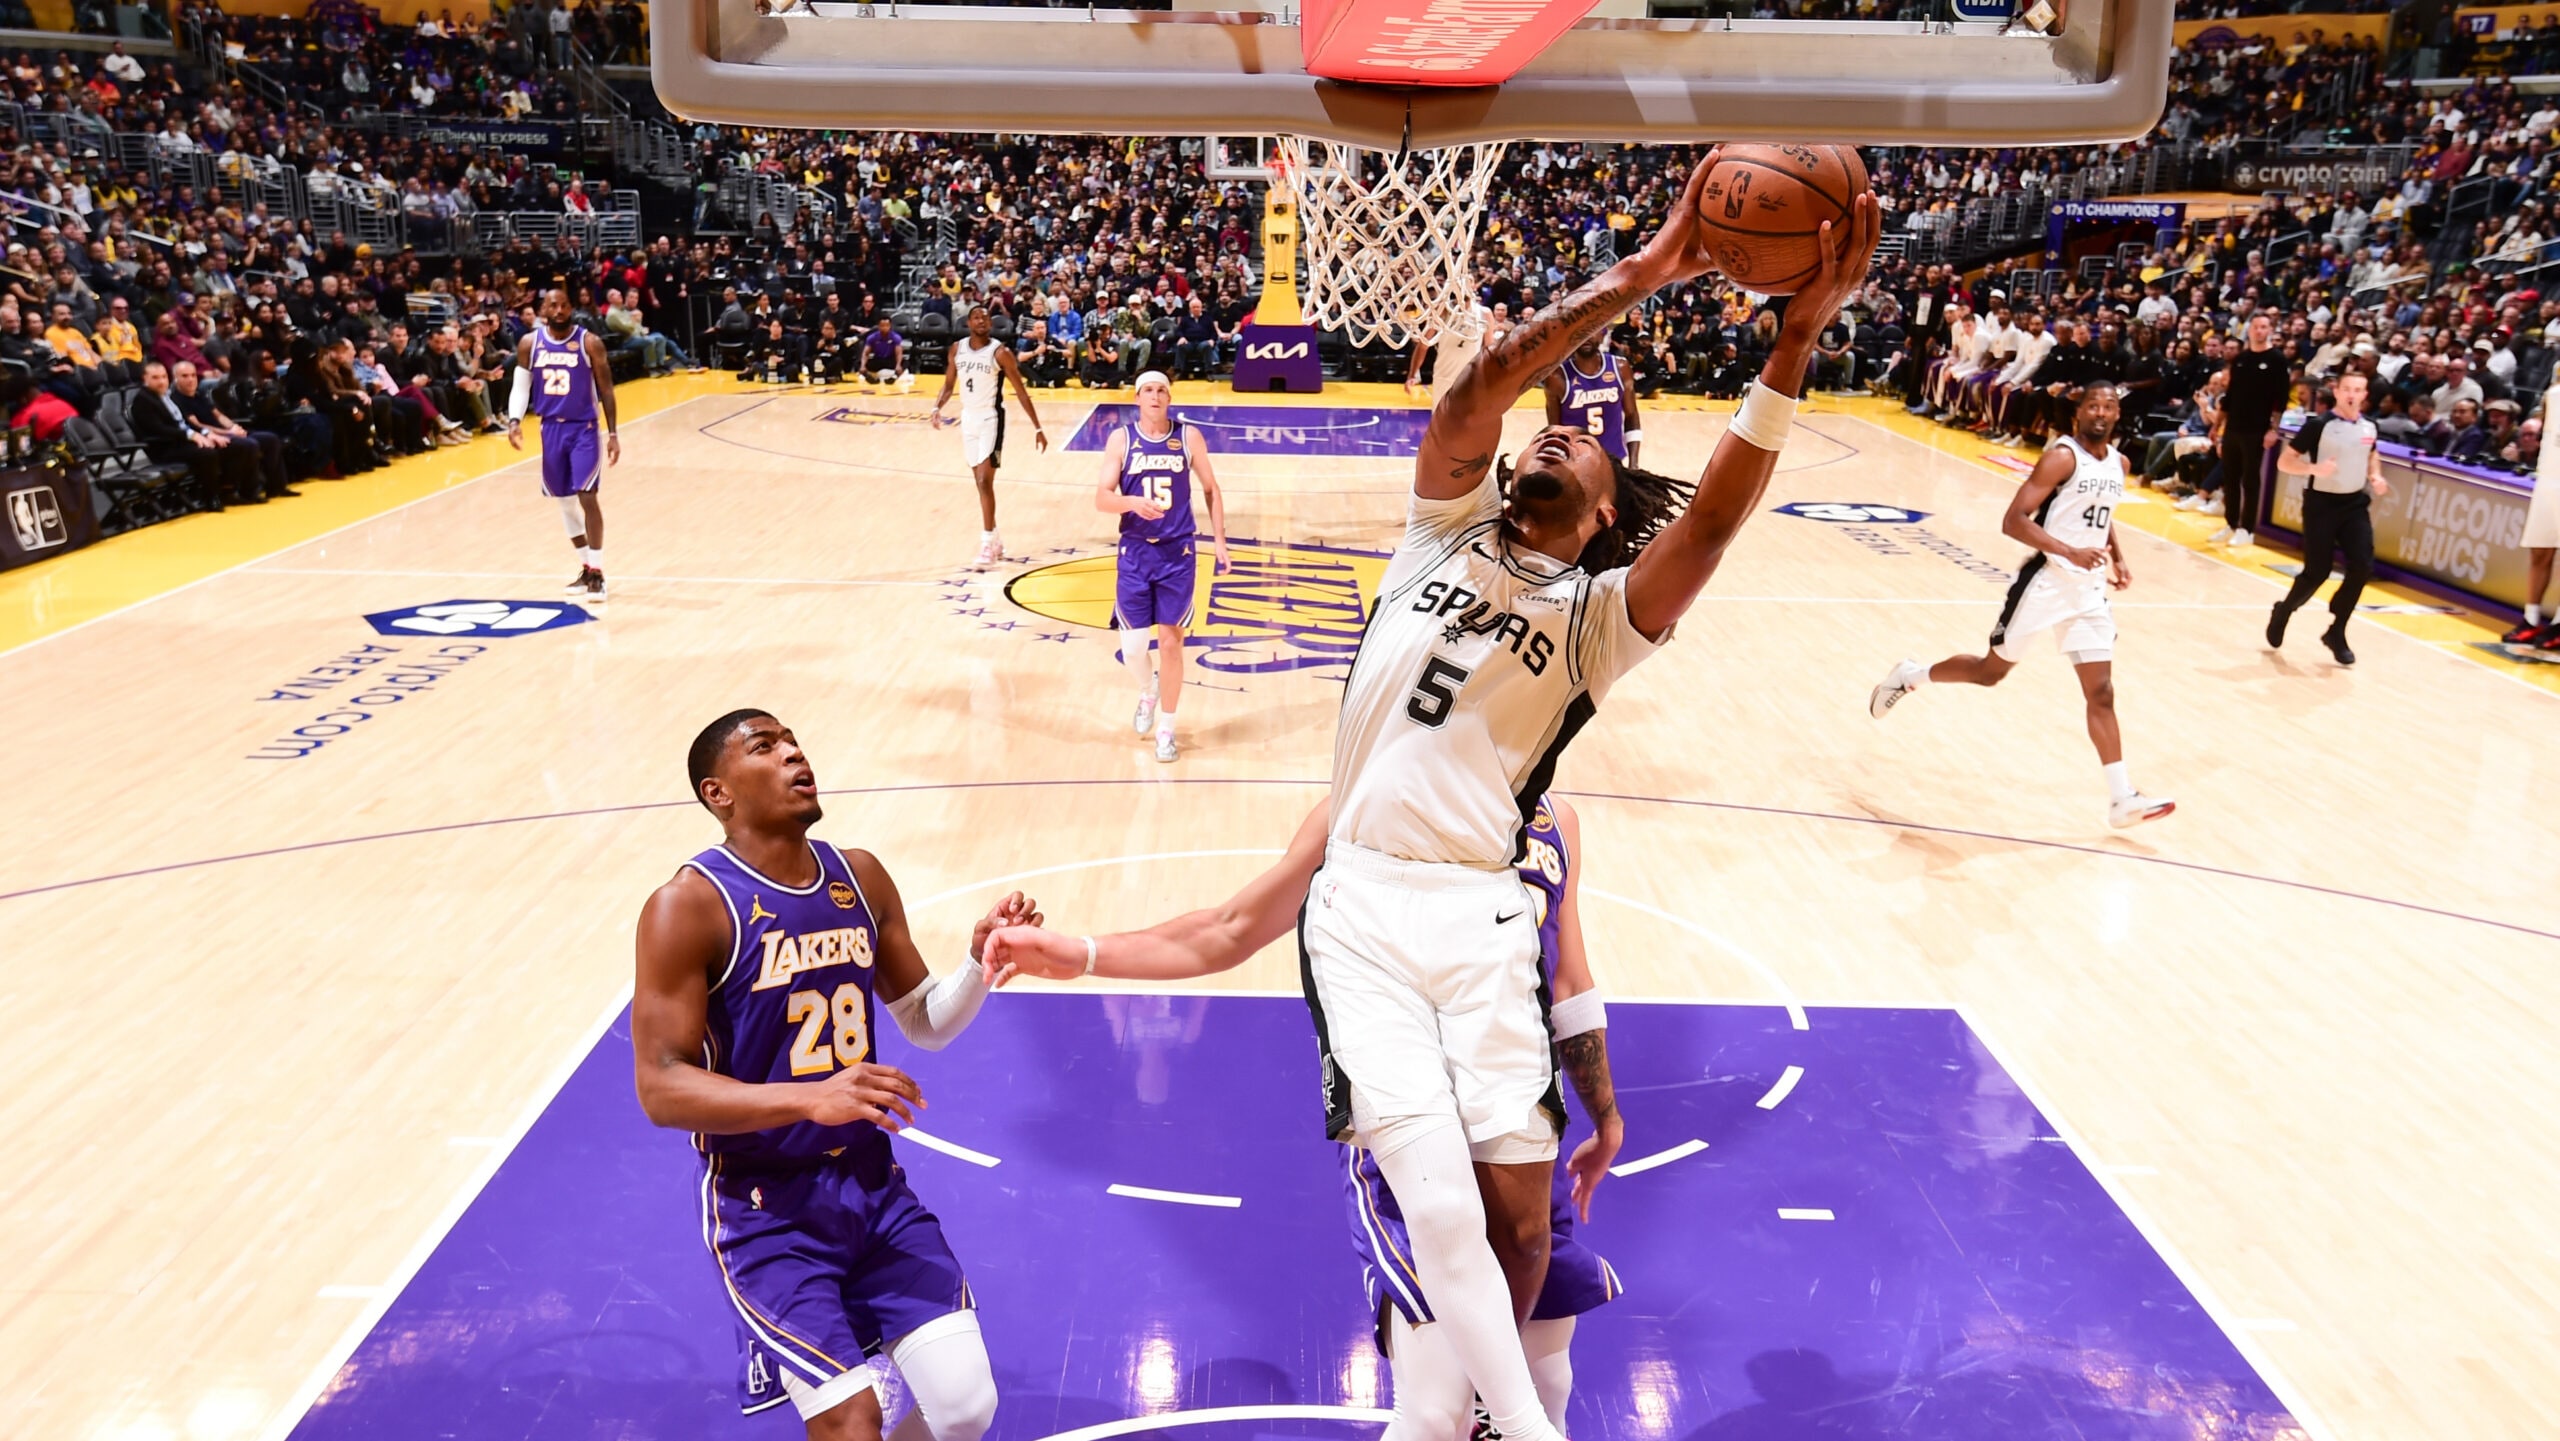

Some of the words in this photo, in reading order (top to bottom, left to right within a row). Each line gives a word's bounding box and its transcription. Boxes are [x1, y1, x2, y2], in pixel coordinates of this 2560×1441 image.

[2471, 17, 2489, 33] 17
[490, 132, 549, 145] EXPRESS
[2258, 163, 2387, 187] cryptocom
[2065, 203, 2085, 217] 17x
[2085, 203, 2160, 218] CHAMPIONS
[534, 349, 579, 368] LAKERS
[1246, 342, 1308, 359] KIA
[956, 360, 992, 375] SPURS
[542, 368, 571, 396] 23
[966, 378, 974, 392] 4
[1569, 386, 1619, 409] LAKERS
[1587, 406, 1604, 436] 5
[1127, 451, 1184, 475] LAKERS
[1141, 476, 1172, 511] 15
[2082, 504, 2110, 529] 40
[2405, 482, 2526, 550] FALCONS
[1892, 526, 2012, 583] crypto.com
[2416, 527, 2489, 584] BUCS
[1525, 594, 1561, 606] LEDGER
[1411, 580, 1556, 677] SPURS
[254, 643, 403, 702] ARENA
[245, 644, 488, 760] crypto.com
[1404, 652, 1474, 731] 5
[751, 925, 874, 993] LAKERS
[786, 981, 870, 1078] 28
